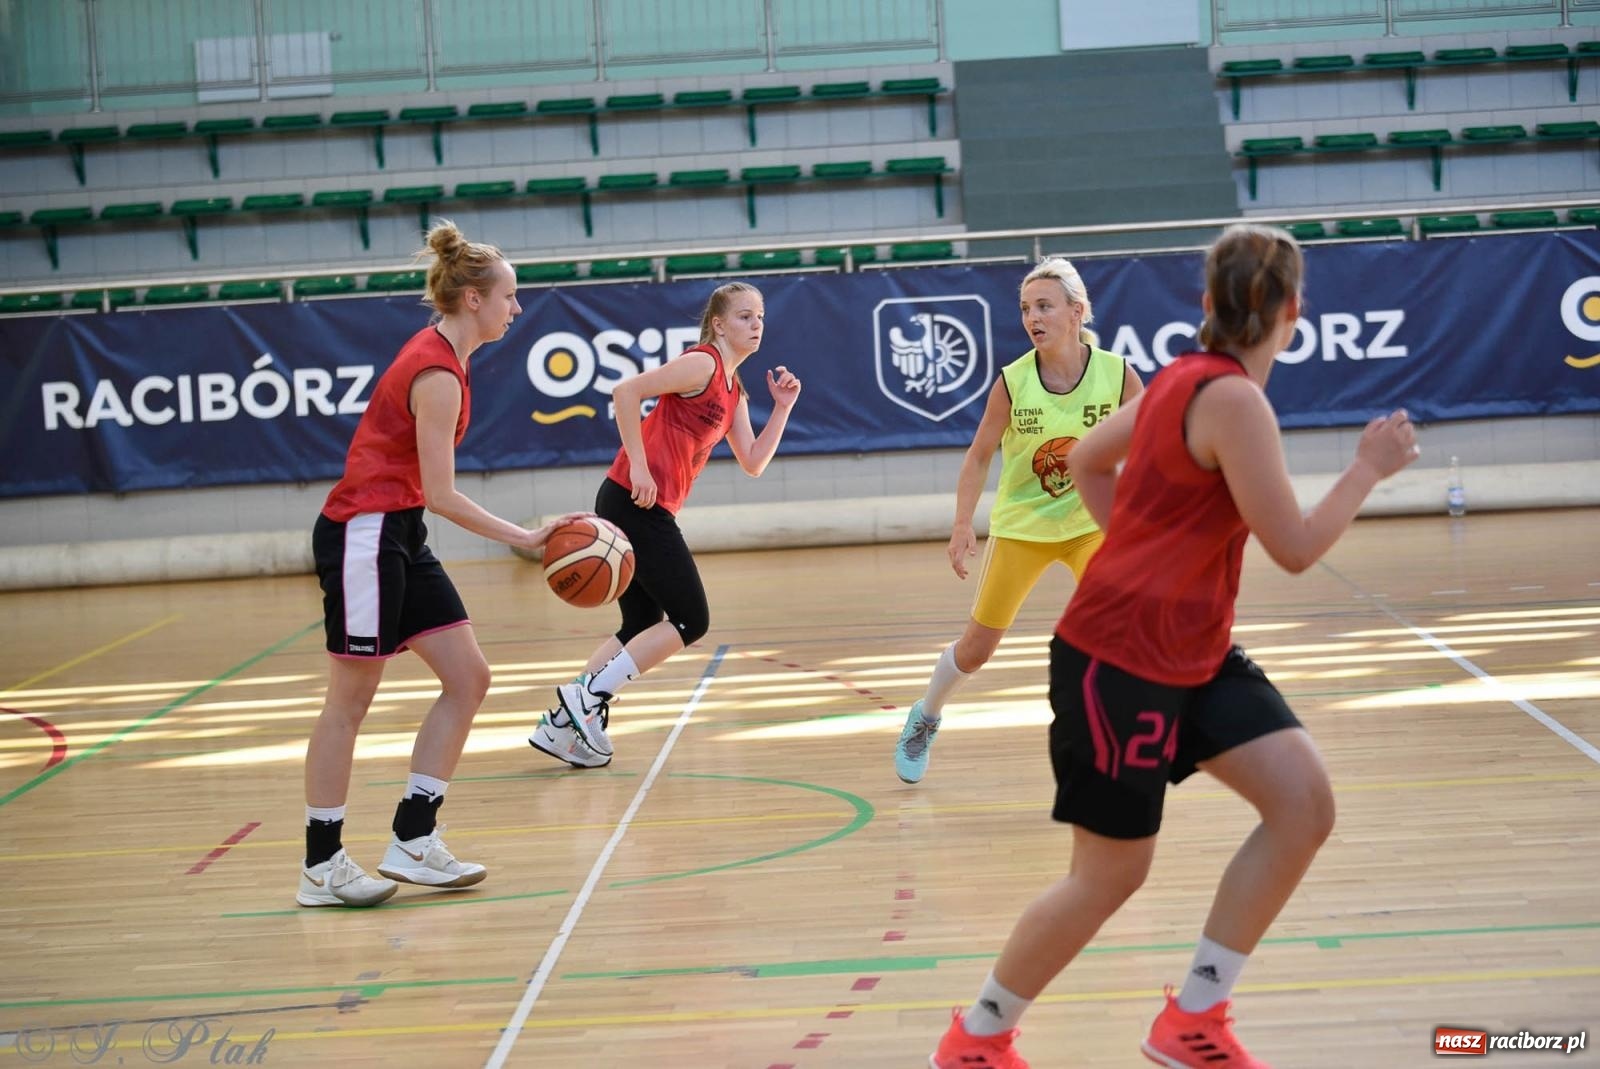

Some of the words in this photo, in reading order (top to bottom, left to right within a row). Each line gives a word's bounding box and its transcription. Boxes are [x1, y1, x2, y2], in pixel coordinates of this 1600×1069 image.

[42, 352, 375, 430] RACIBÓRZ
[1013, 408, 1044, 417] LETNIA
[1018, 417, 1039, 427] LIGA
